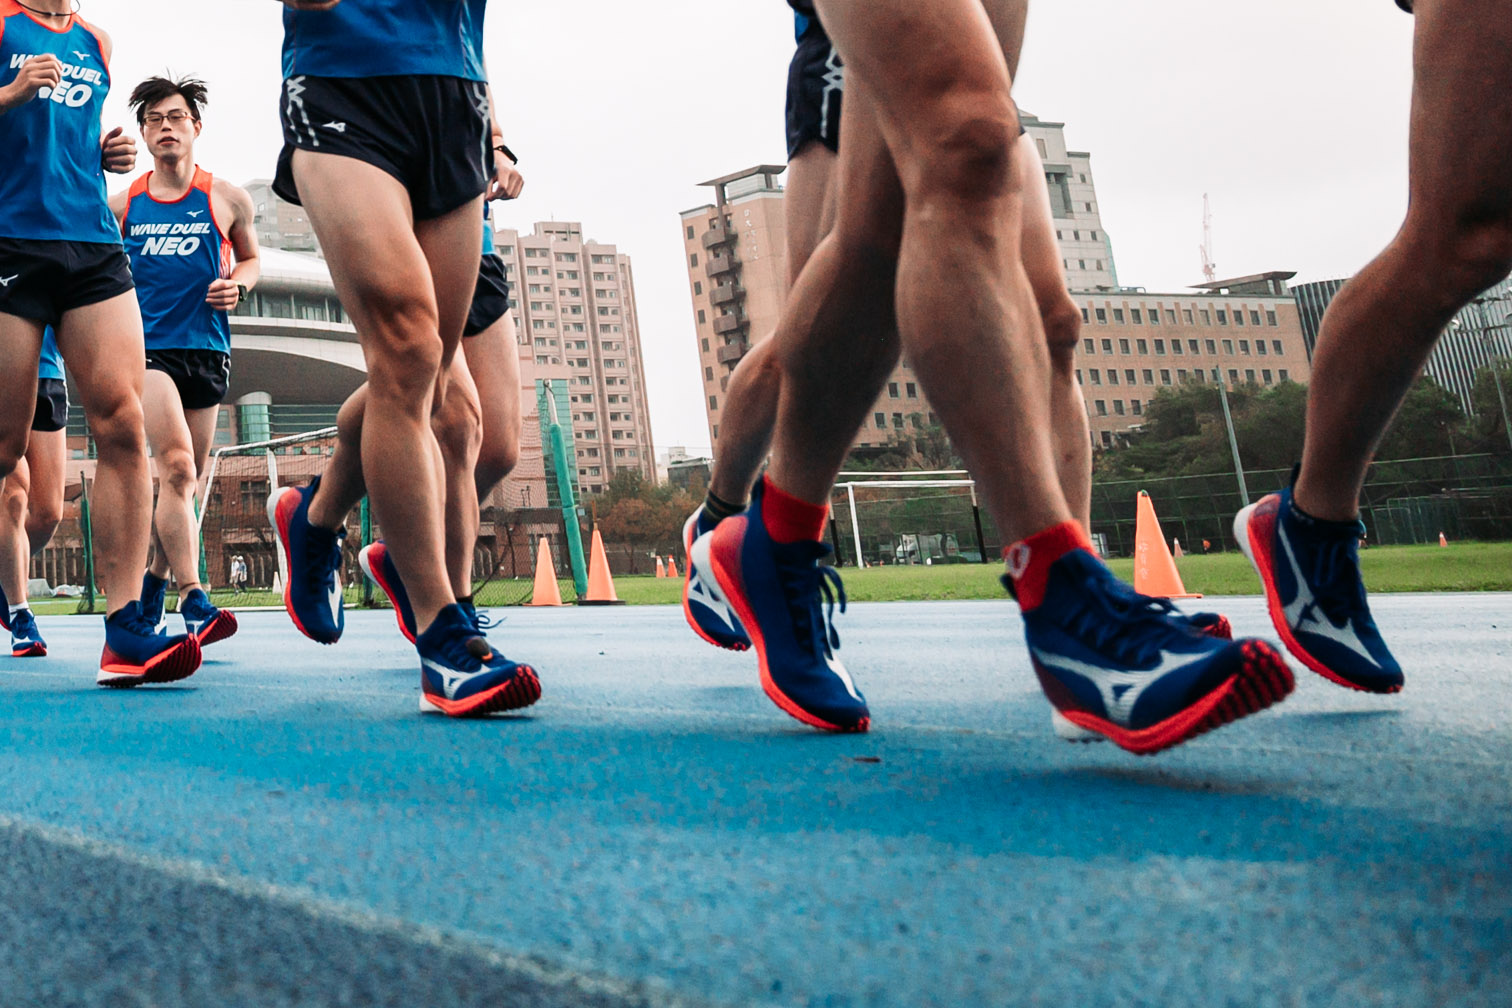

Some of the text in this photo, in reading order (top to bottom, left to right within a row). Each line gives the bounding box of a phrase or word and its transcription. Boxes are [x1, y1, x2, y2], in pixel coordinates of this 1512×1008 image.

[130, 222, 211, 236] WAVE DUEL
[140, 236, 201, 256] NEO
